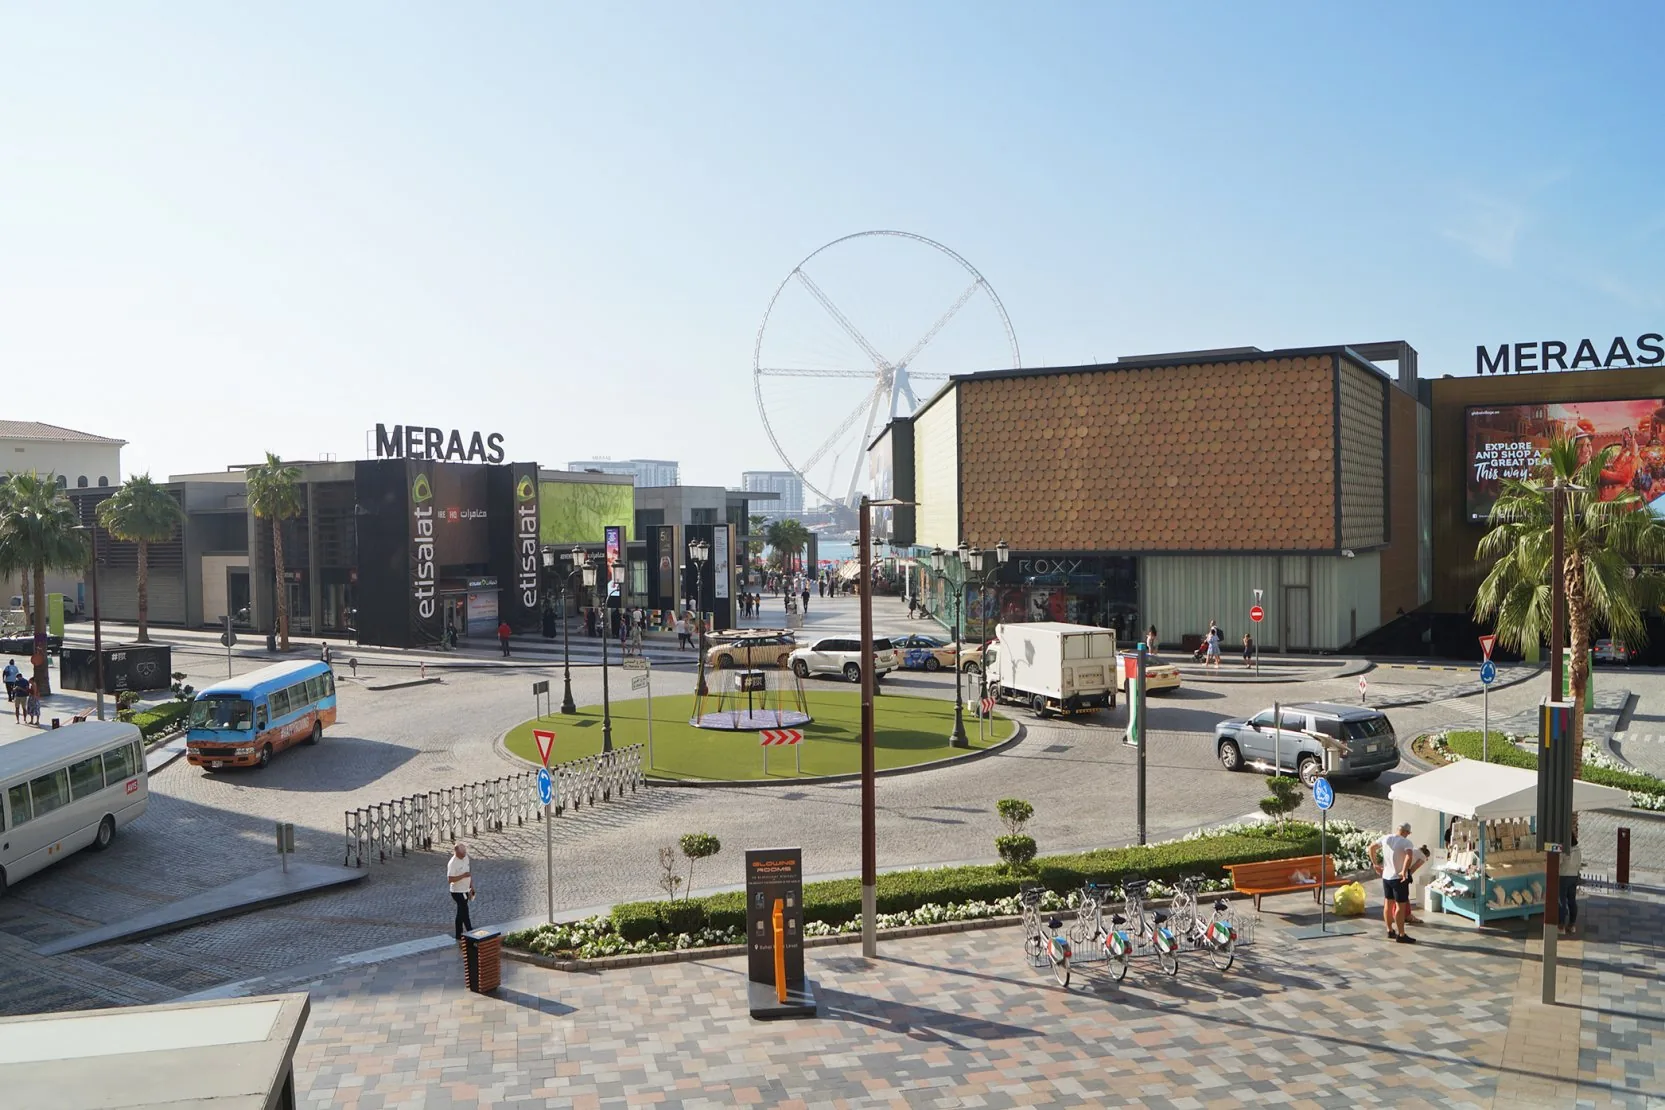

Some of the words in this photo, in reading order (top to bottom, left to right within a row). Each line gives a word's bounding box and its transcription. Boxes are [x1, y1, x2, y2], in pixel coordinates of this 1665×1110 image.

[1476, 333, 1665, 374] MERAAS
[375, 423, 505, 463] MERAAS
[1485, 442, 1532, 451] EXPLORE
[1475, 451, 1498, 459] AND
[1501, 450, 1531, 458] SHOP
[1533, 450, 1542, 458] A
[1490, 458, 1524, 467] GREAT
[1474, 462, 1499, 483] This
[414, 505, 435, 618] etisalat
[518, 504, 537, 608] etisalat
[1018, 559, 1082, 574] ROXY
